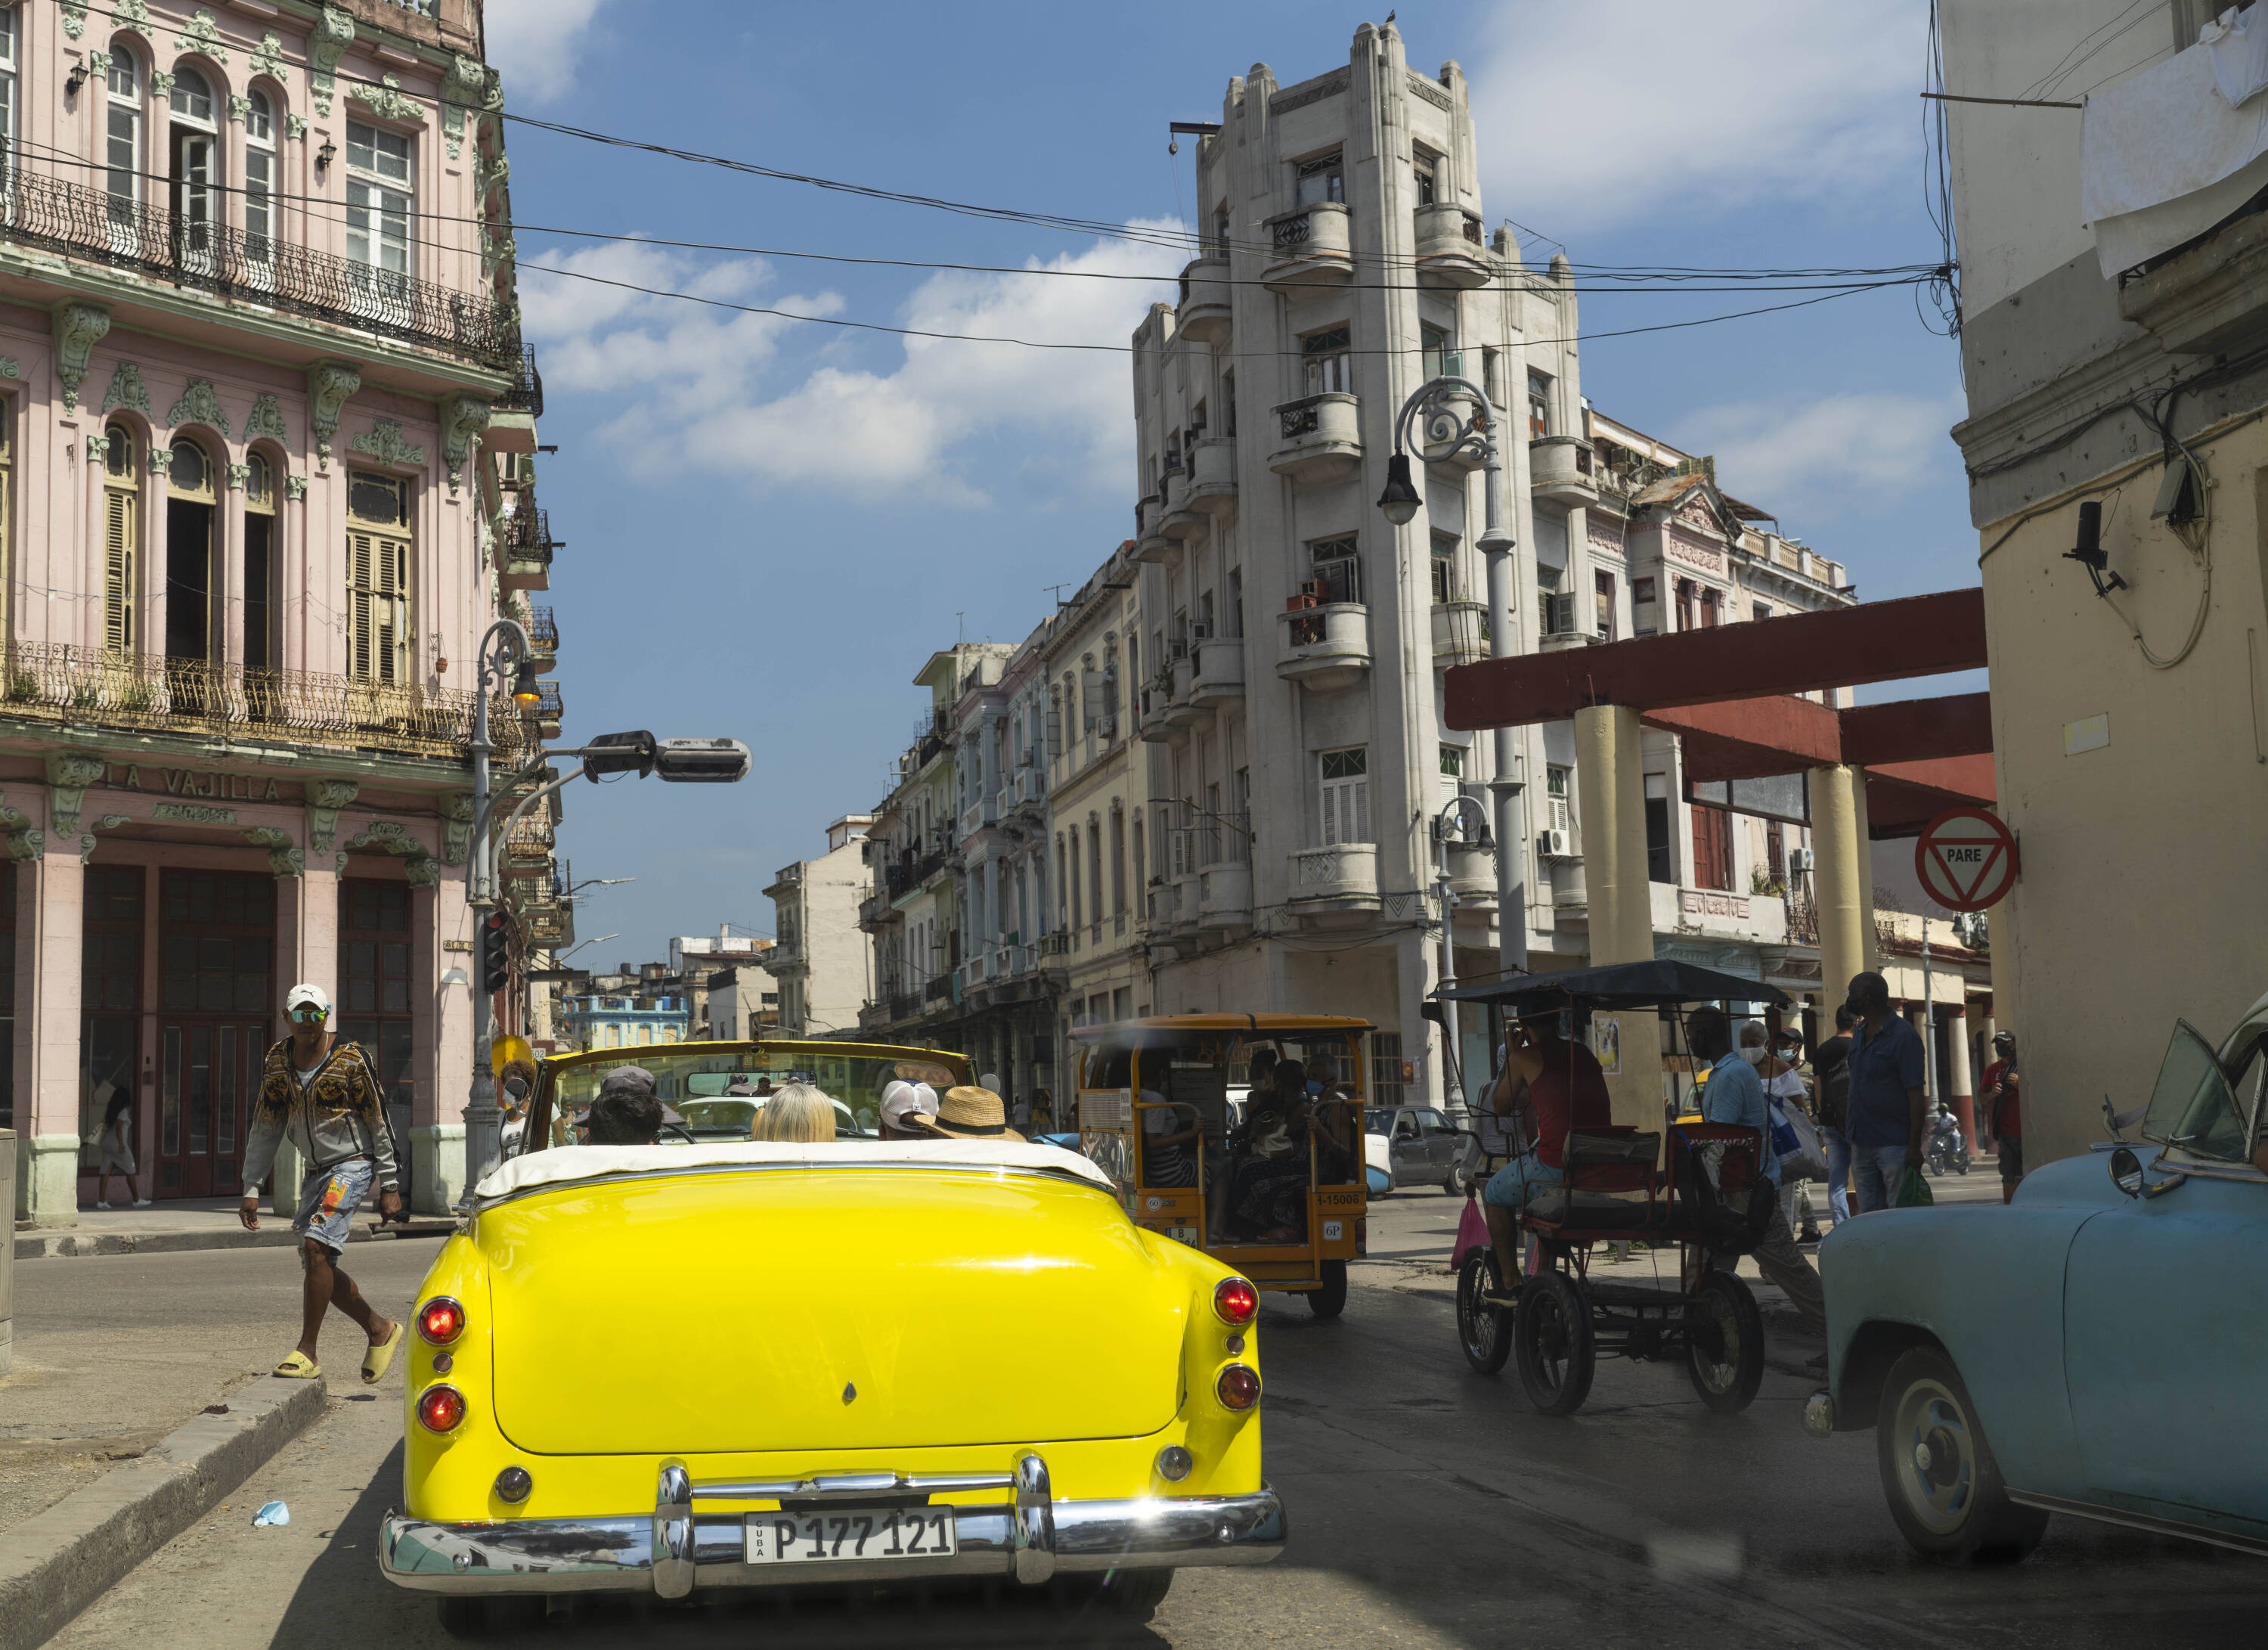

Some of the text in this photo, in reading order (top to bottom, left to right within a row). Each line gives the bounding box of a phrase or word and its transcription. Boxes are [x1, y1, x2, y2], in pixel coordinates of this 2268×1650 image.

[107, 763, 280, 799] LA VAJILLA
[1947, 848, 1981, 862] PARE
[1179, 1228, 1185, 1238] B
[1326, 1225, 1340, 1236] 6P
[756, 1520, 764, 1557] CUBA
